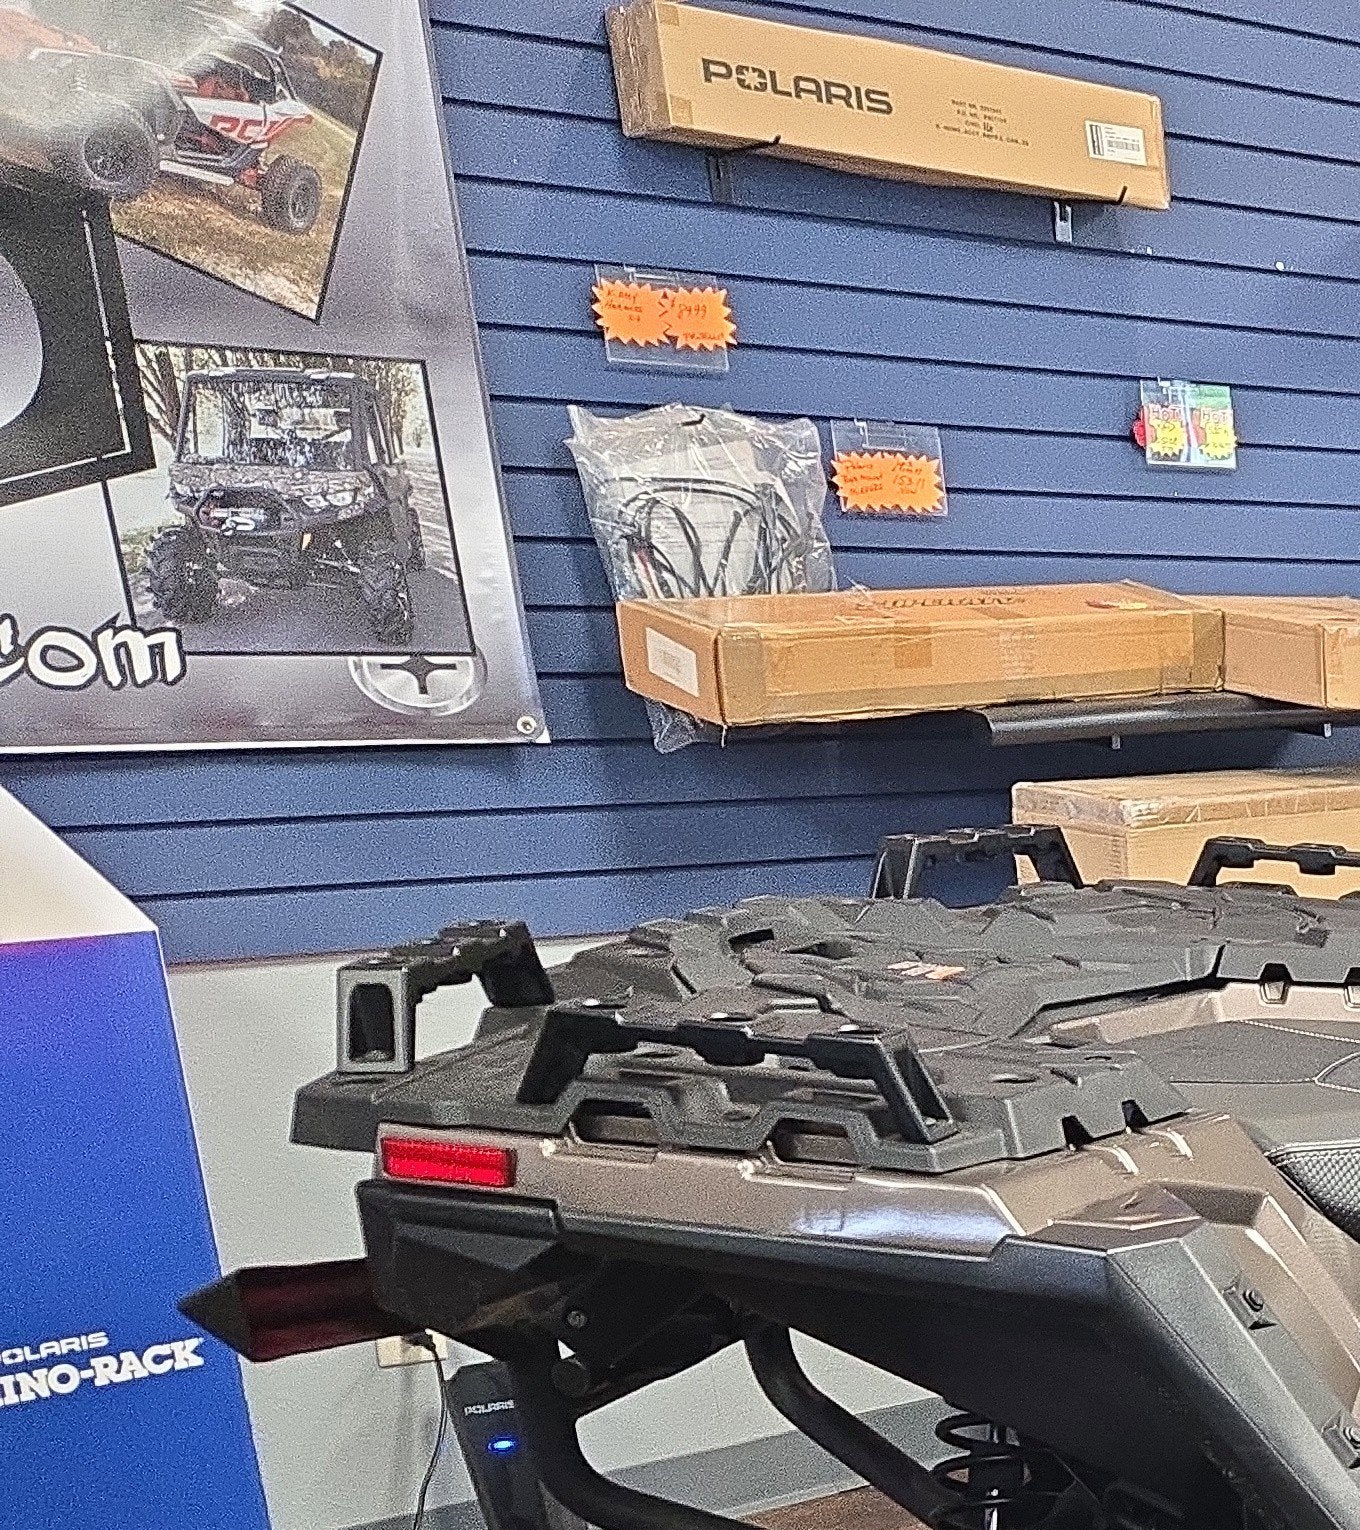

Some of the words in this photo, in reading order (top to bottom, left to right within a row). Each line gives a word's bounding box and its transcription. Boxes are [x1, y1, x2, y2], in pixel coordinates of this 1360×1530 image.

[701, 58, 893, 115] POLARIS
[0, 1332, 109, 1365] OLARIS
[0, 1337, 205, 1407] INO-RACK
[464, 1399, 515, 1416] POLARIS
